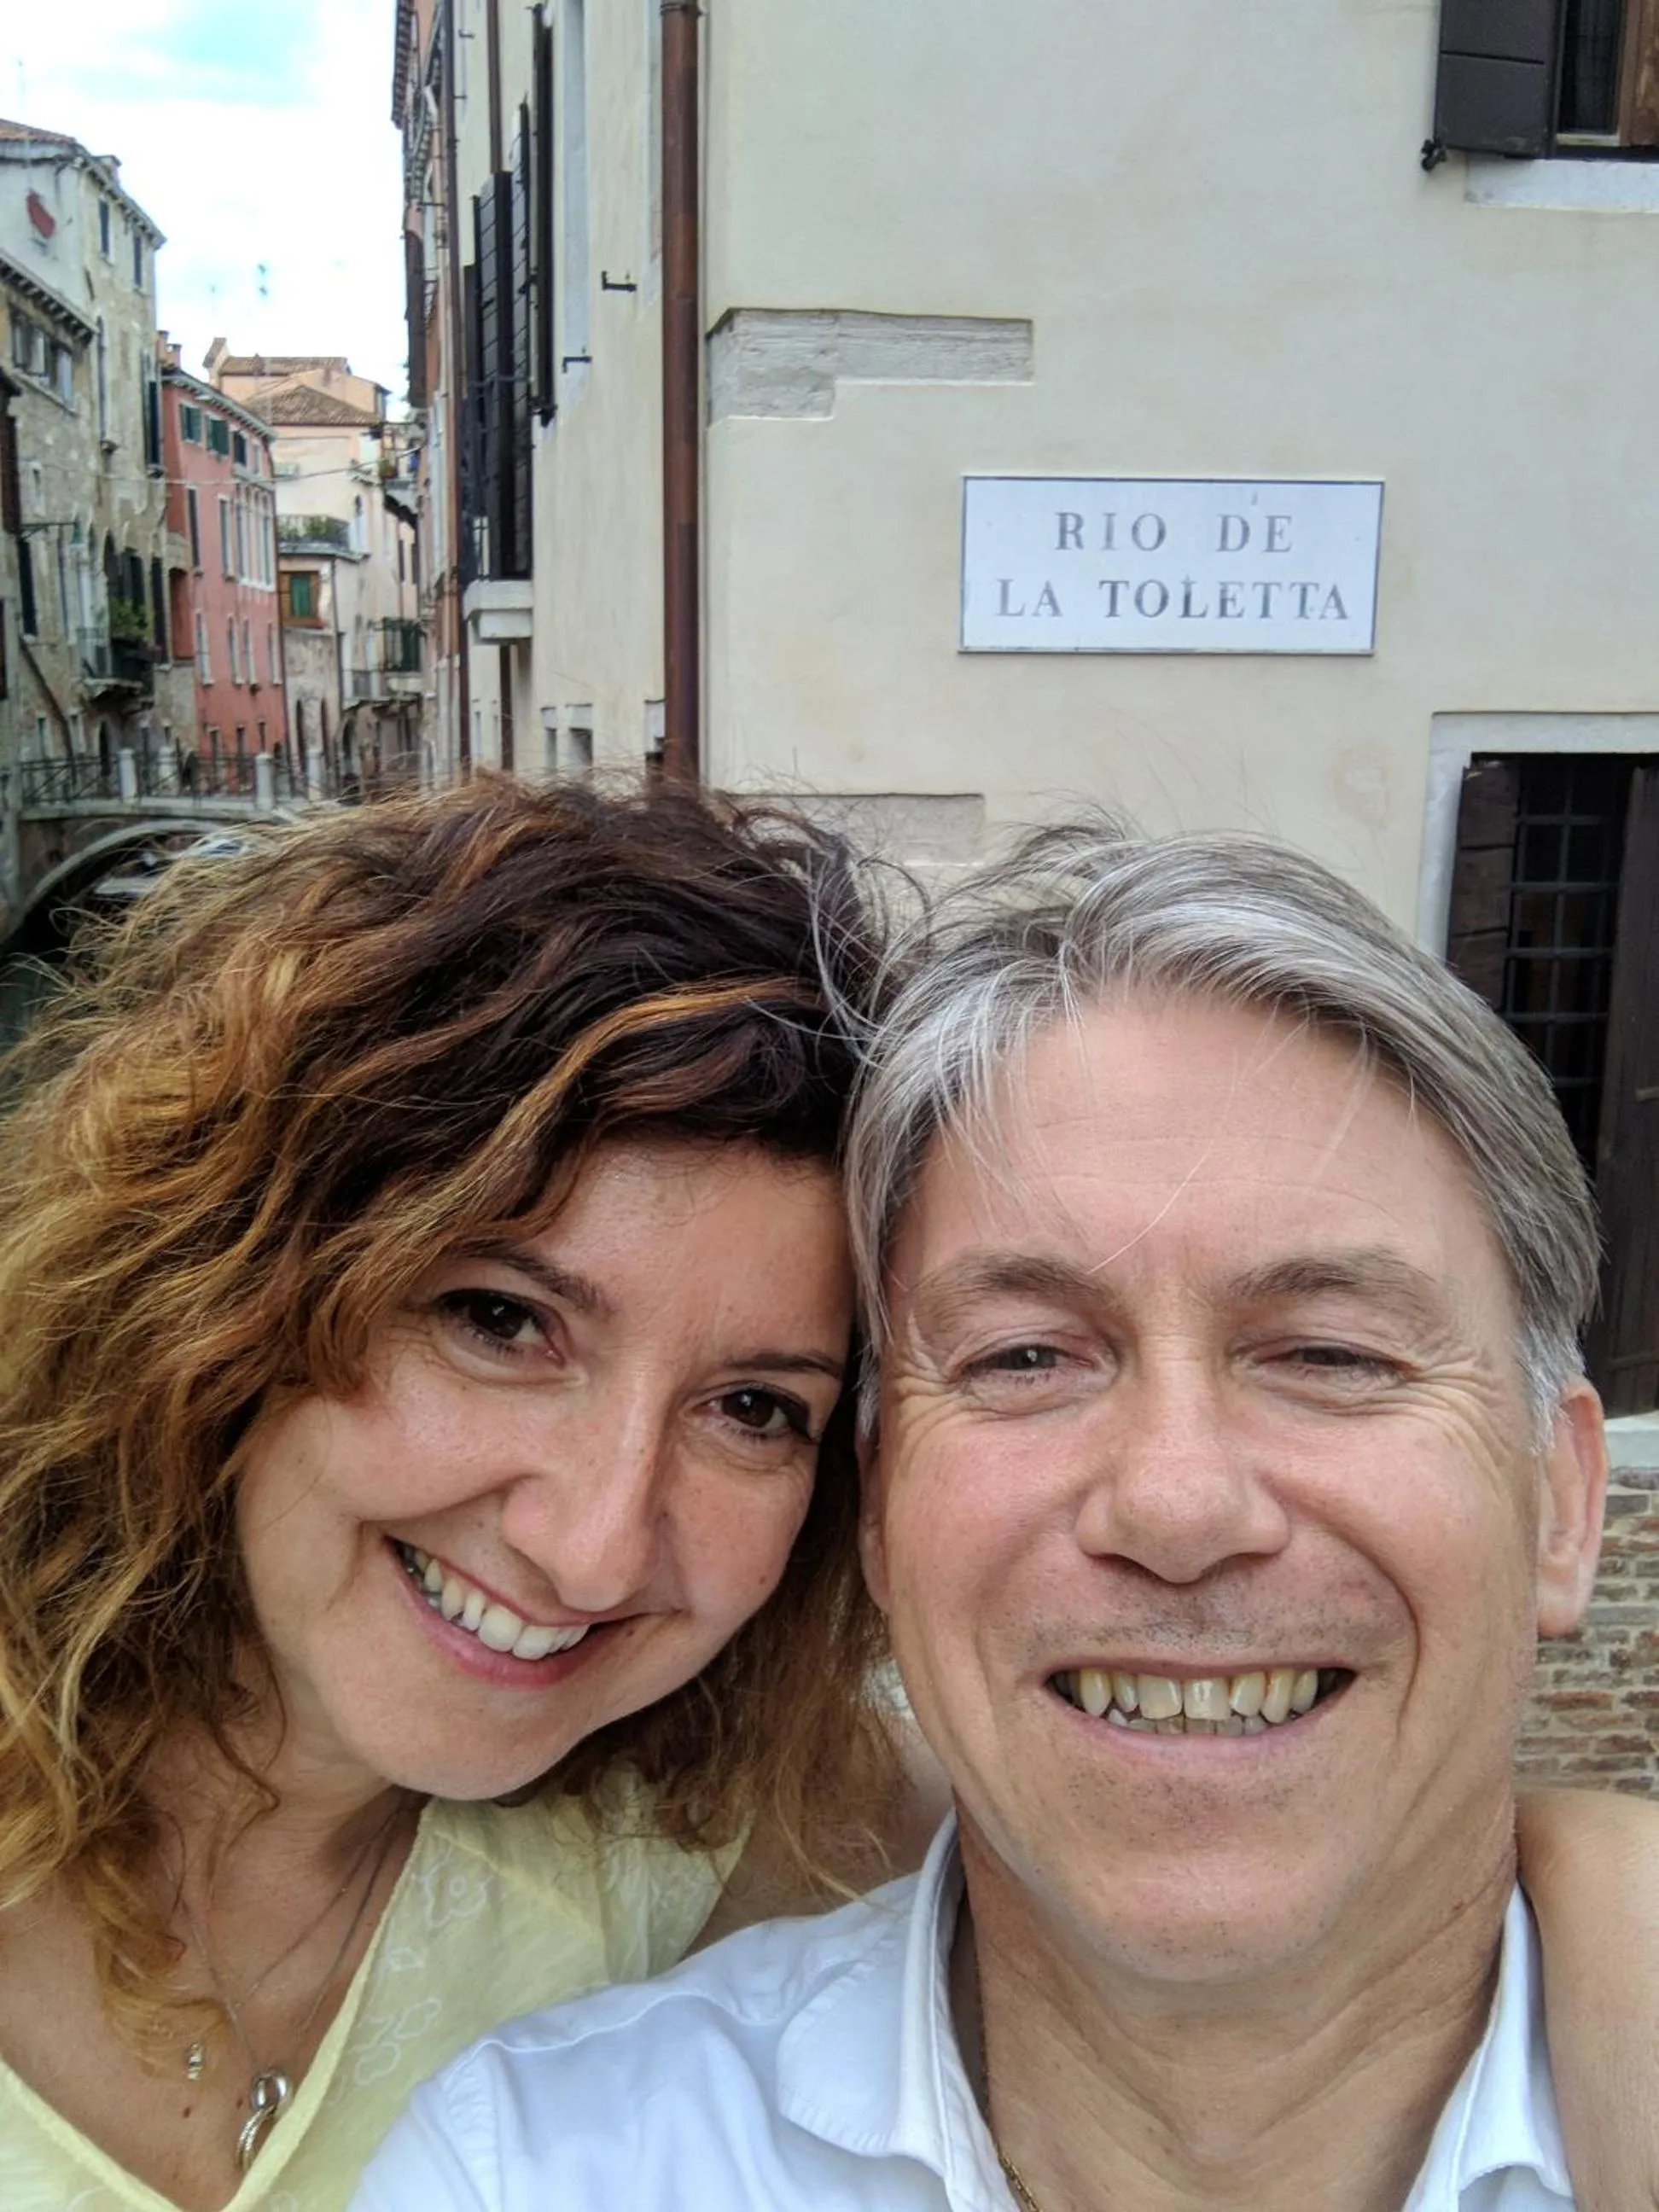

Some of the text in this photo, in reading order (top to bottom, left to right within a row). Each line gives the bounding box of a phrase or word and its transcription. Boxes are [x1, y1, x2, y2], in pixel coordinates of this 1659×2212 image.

[1055, 512, 1293, 553] RIO DE
[996, 579, 1349, 620] LA TOLETTA
